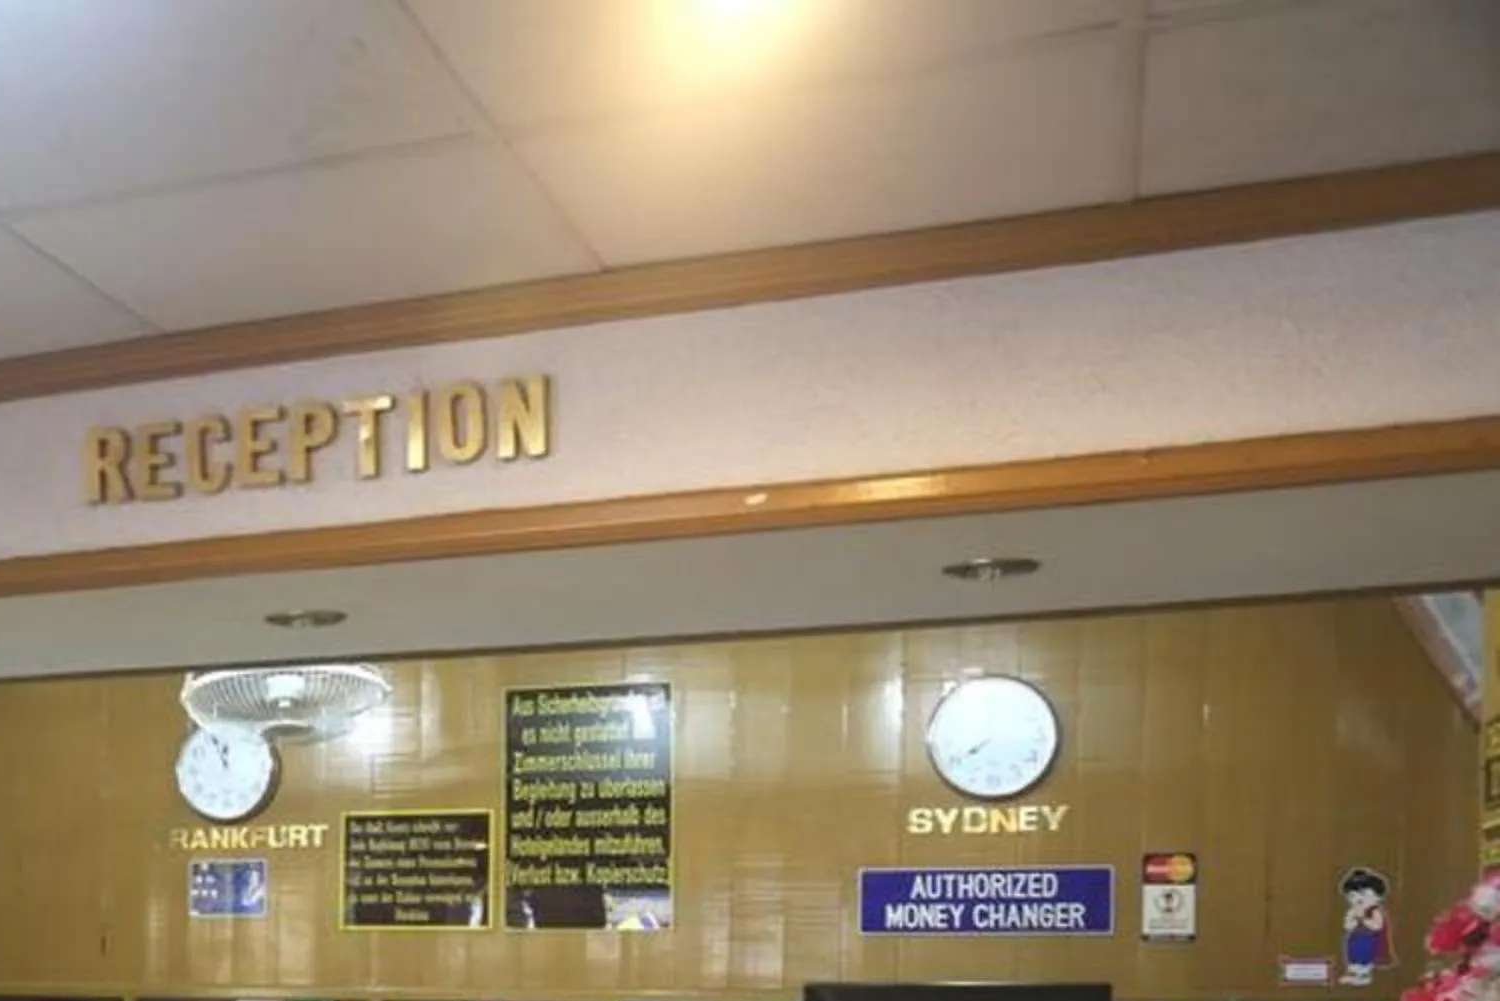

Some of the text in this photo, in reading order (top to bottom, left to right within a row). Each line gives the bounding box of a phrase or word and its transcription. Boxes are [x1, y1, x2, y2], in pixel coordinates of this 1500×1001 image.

[82, 373, 551, 504] RECEPTION
[907, 804, 1070, 834] SYDNEY
[158, 823, 329, 850] RANKFURT
[910, 872, 1059, 900] AUTHORIZED
[885, 903, 1086, 929] MONEY CHANGER
